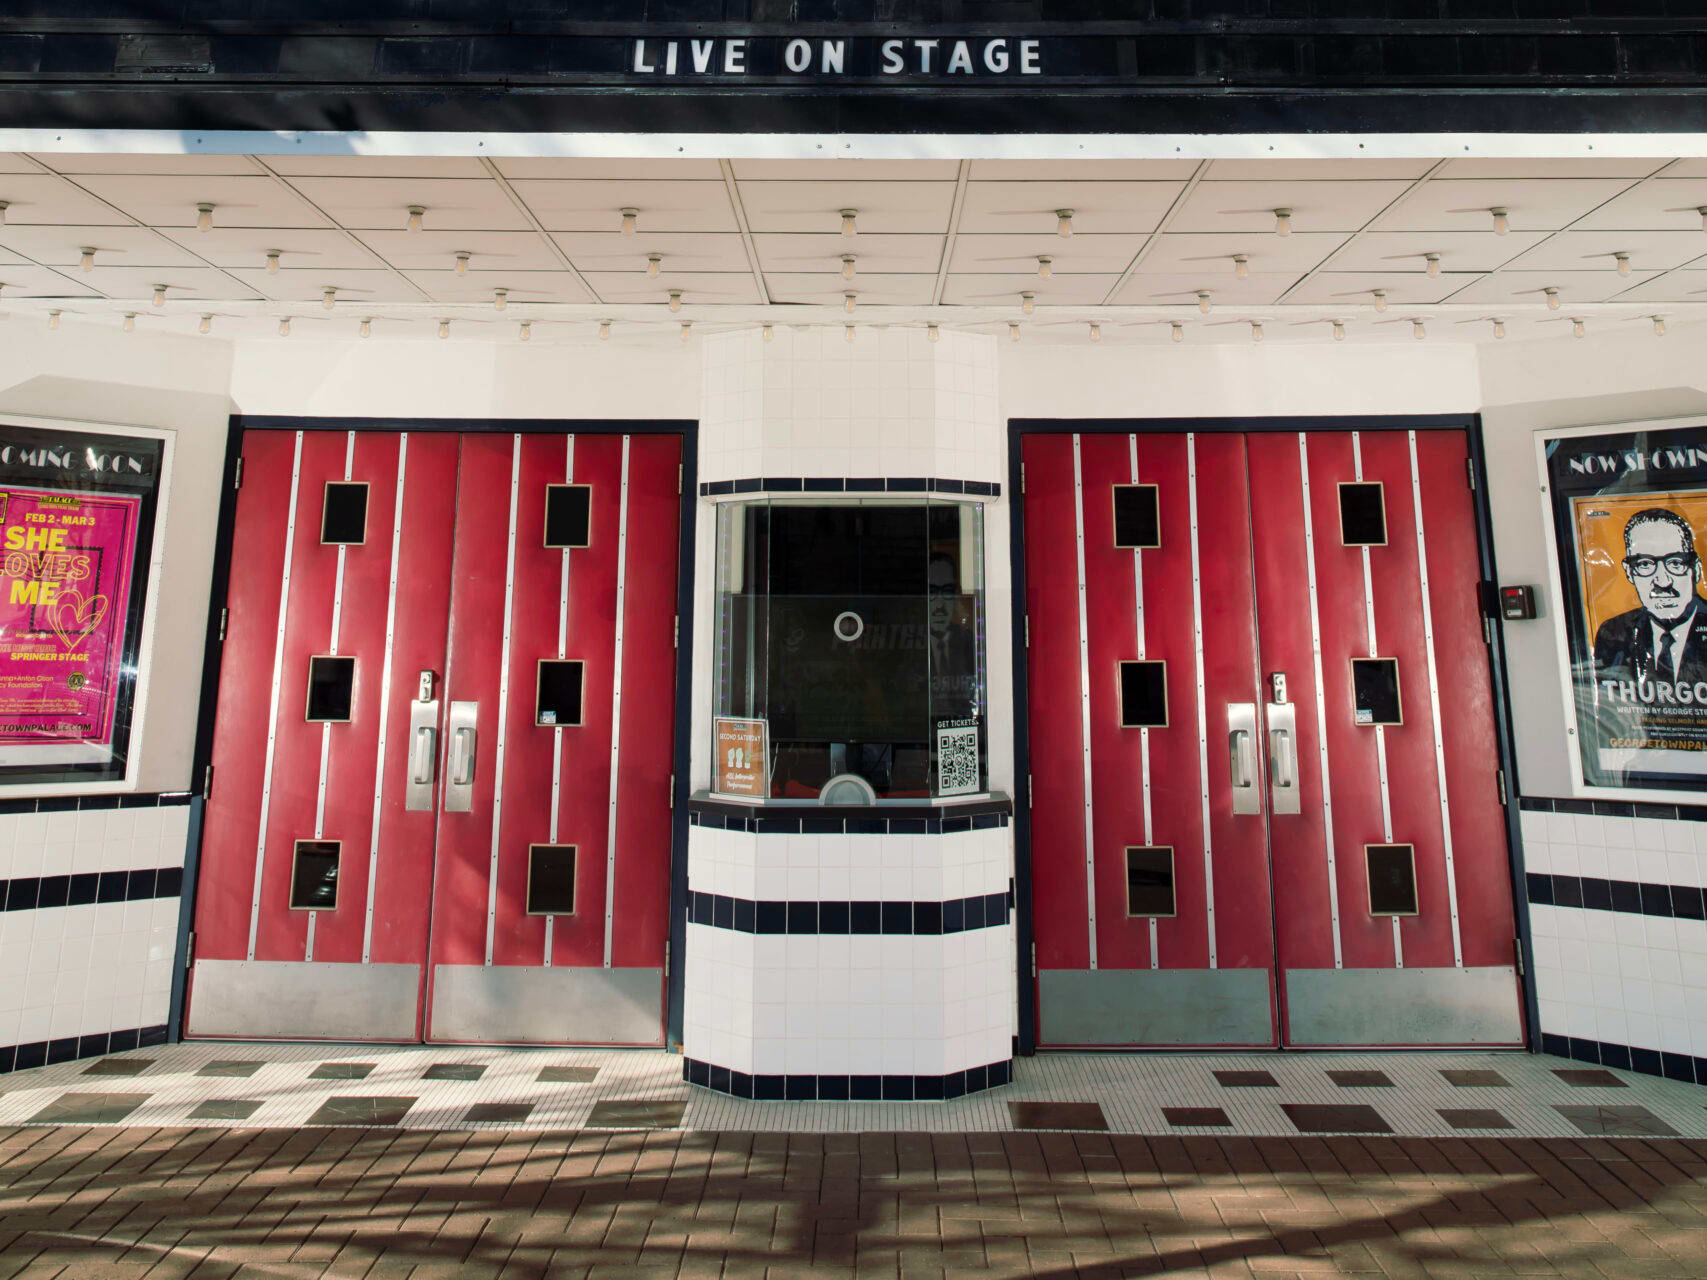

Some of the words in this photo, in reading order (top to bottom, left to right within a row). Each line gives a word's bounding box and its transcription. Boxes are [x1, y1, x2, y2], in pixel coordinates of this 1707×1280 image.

[634, 38, 746, 75] LIVE
[785, 38, 844, 74] ON
[881, 38, 1042, 75] STAGE
[0, 444, 78, 471] OMING
[1569, 454, 1619, 475] NOW
[25, 512, 46, 523] FEB
[47, 514, 55, 524] 2
[62, 515, 87, 526] MAR
[88, 517, 96, 527] 3
[4, 525, 68, 552] SHE
[9, 580, 60, 606] ME
[10, 652, 58, 662] SPRINGER
[59, 653, 90, 662] STAGE
[1616, 705, 1650, 715] WRITTEN
[1651, 706, 1661, 715] BY
[1662, 706, 1693, 716] GEORGE
[937, 720, 949, 728] GET
